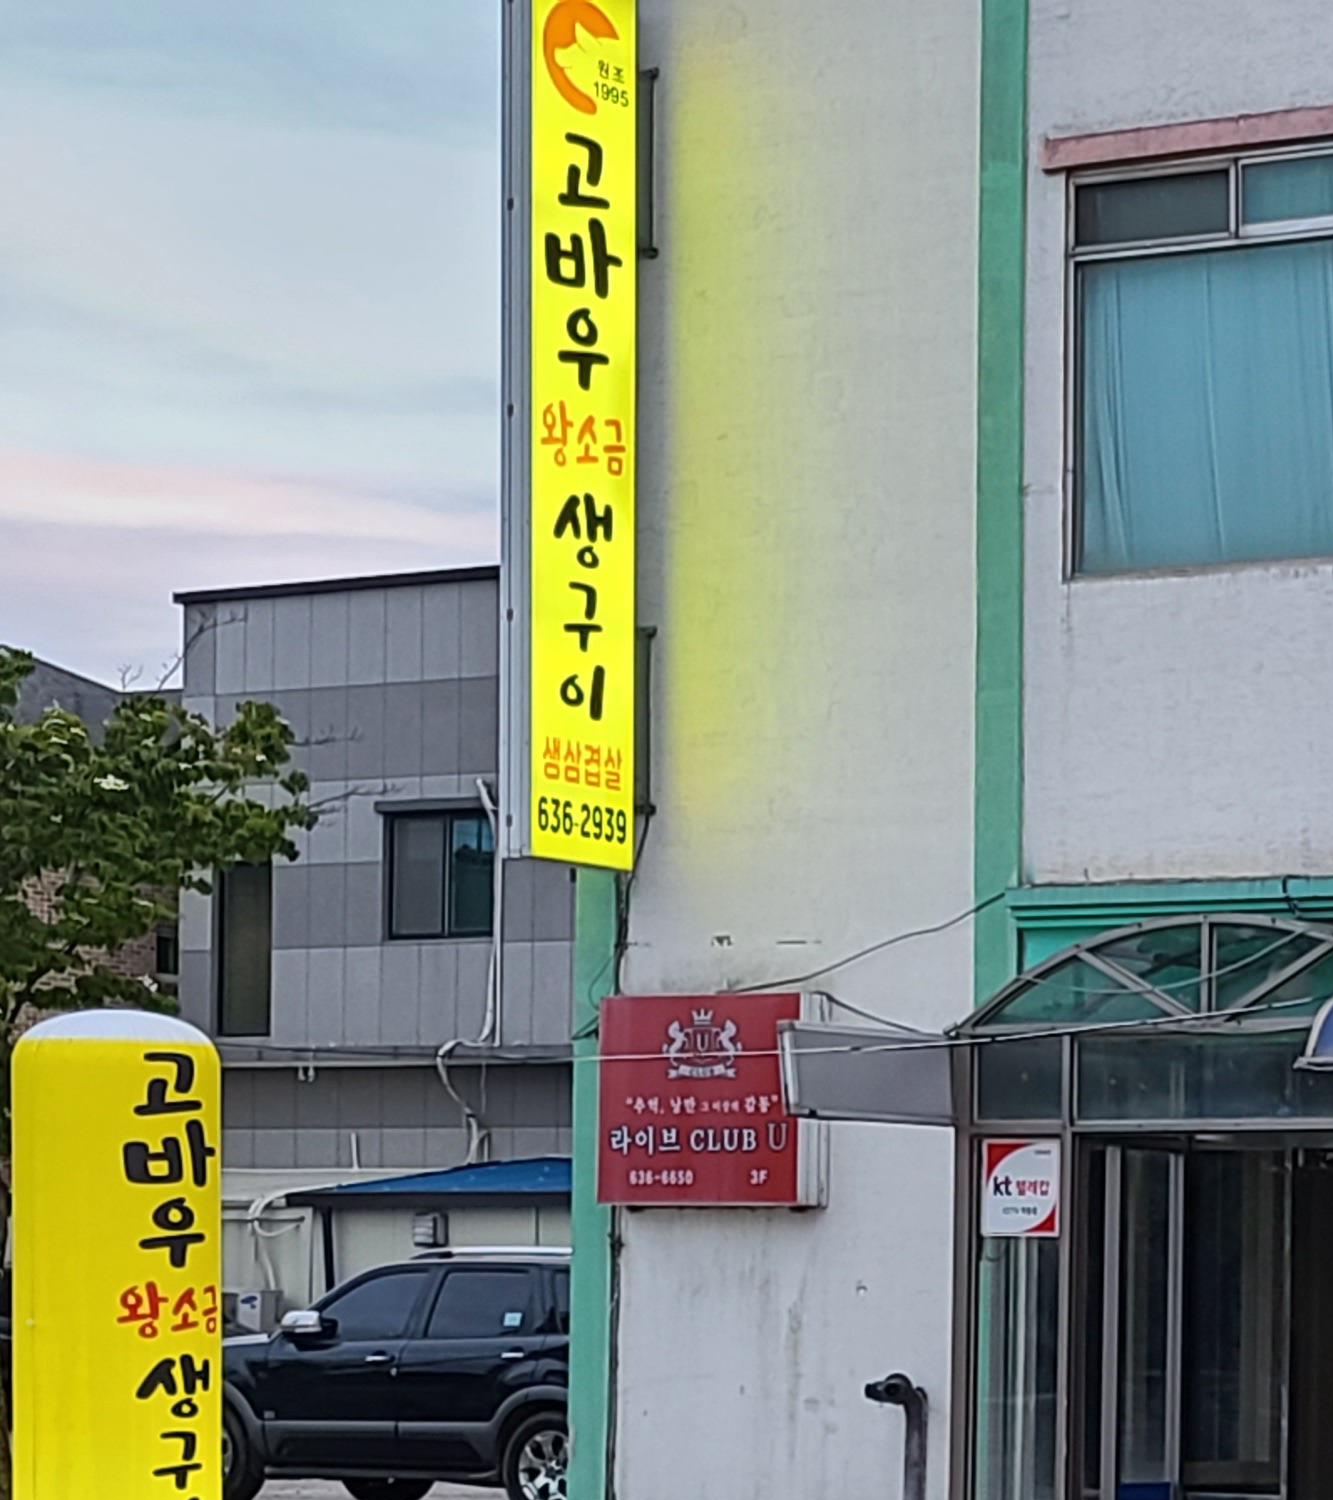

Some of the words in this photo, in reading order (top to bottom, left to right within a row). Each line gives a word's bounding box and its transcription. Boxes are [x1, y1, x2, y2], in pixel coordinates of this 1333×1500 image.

[593, 81, 629, 107] 1995
[597, 59, 625, 84] 원조
[544, 131, 623, 391] 고바우
[540, 400, 626, 477] 왕소금
[553, 493, 613, 721] 생구이
[542, 736, 622, 791] 생삼겹살
[537, 796, 627, 845] 636-2939
[123, 1051, 216, 1269] 고바우
[610, 1126, 680, 1155] 라이브
[690, 1129, 757, 1151] CLUB
[767, 1123, 788, 1150] U
[750, 1169, 768, 1185] 3F
[993, 1175, 1012, 1196] kt
[117, 1281, 218, 1338] 왕소금
